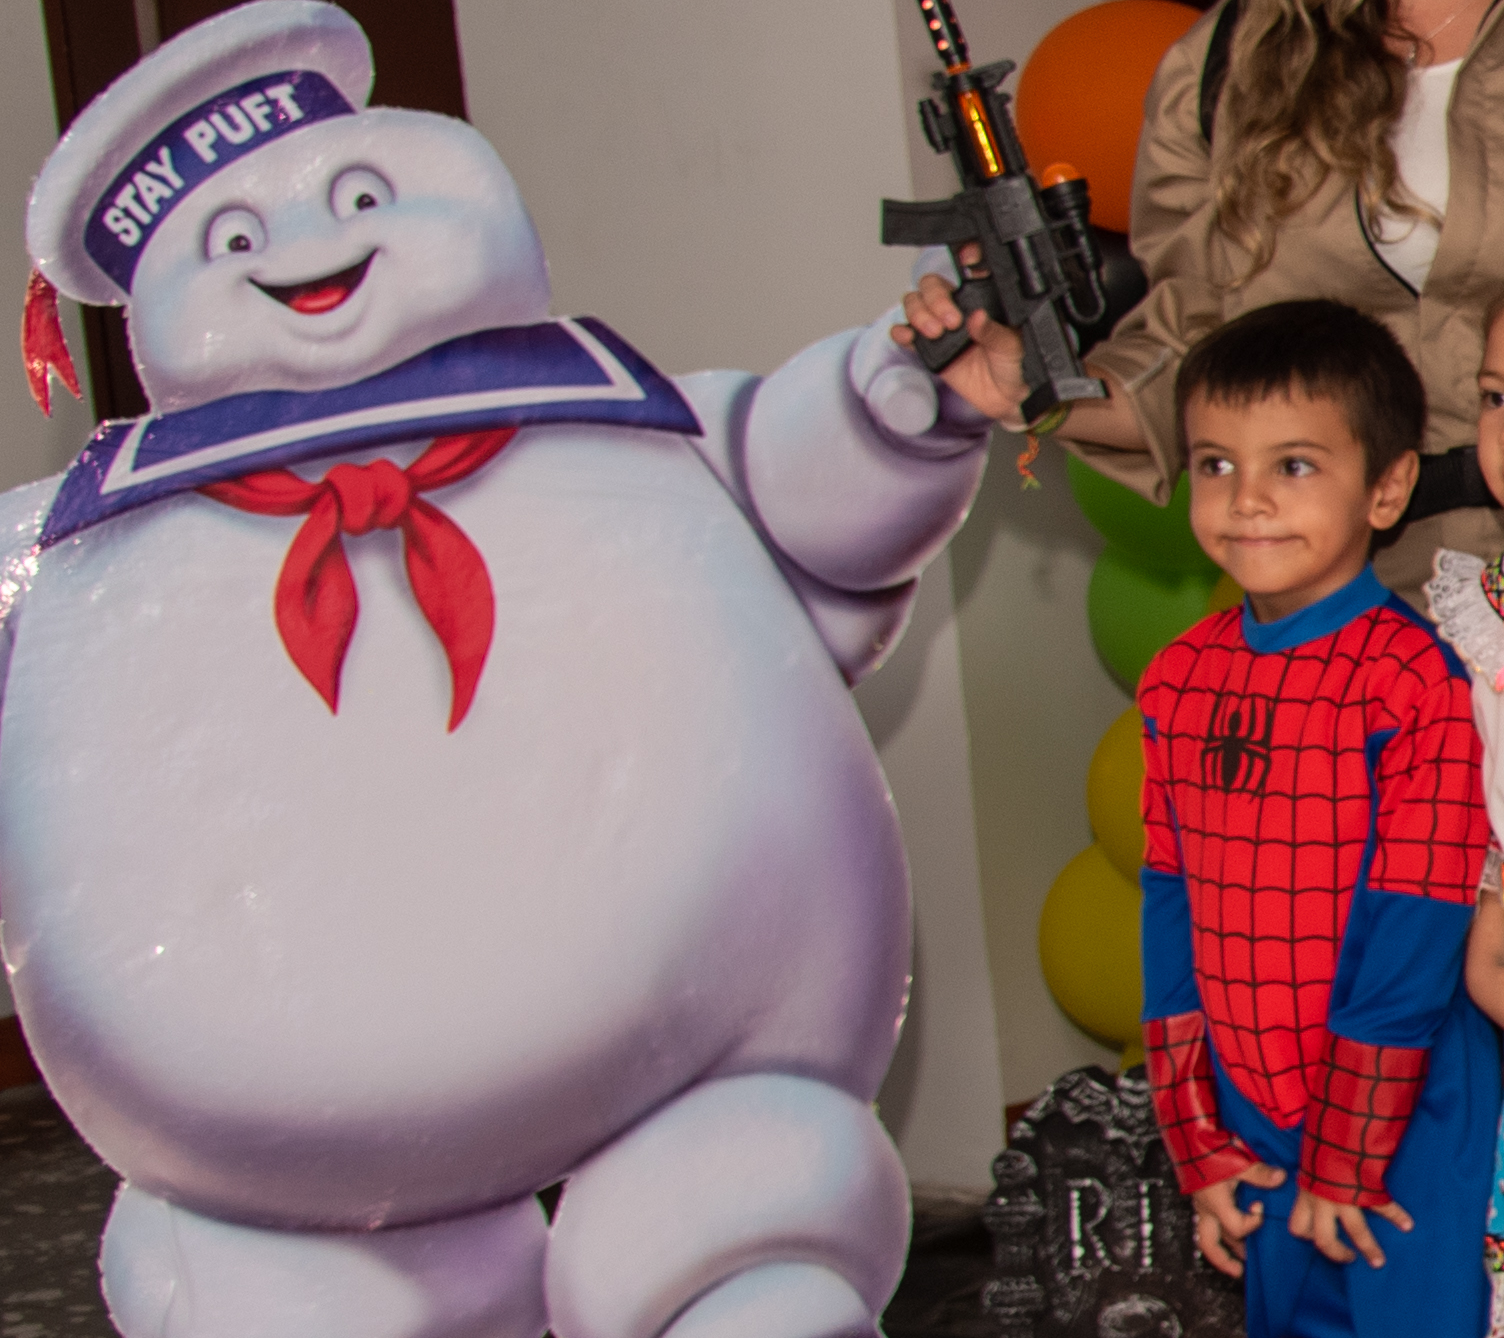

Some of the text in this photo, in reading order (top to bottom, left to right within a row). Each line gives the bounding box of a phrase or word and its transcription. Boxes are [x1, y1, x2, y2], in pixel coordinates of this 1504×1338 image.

[102, 83, 304, 247] STAY PUFT
[1064, 1175, 1204, 1278] RI
